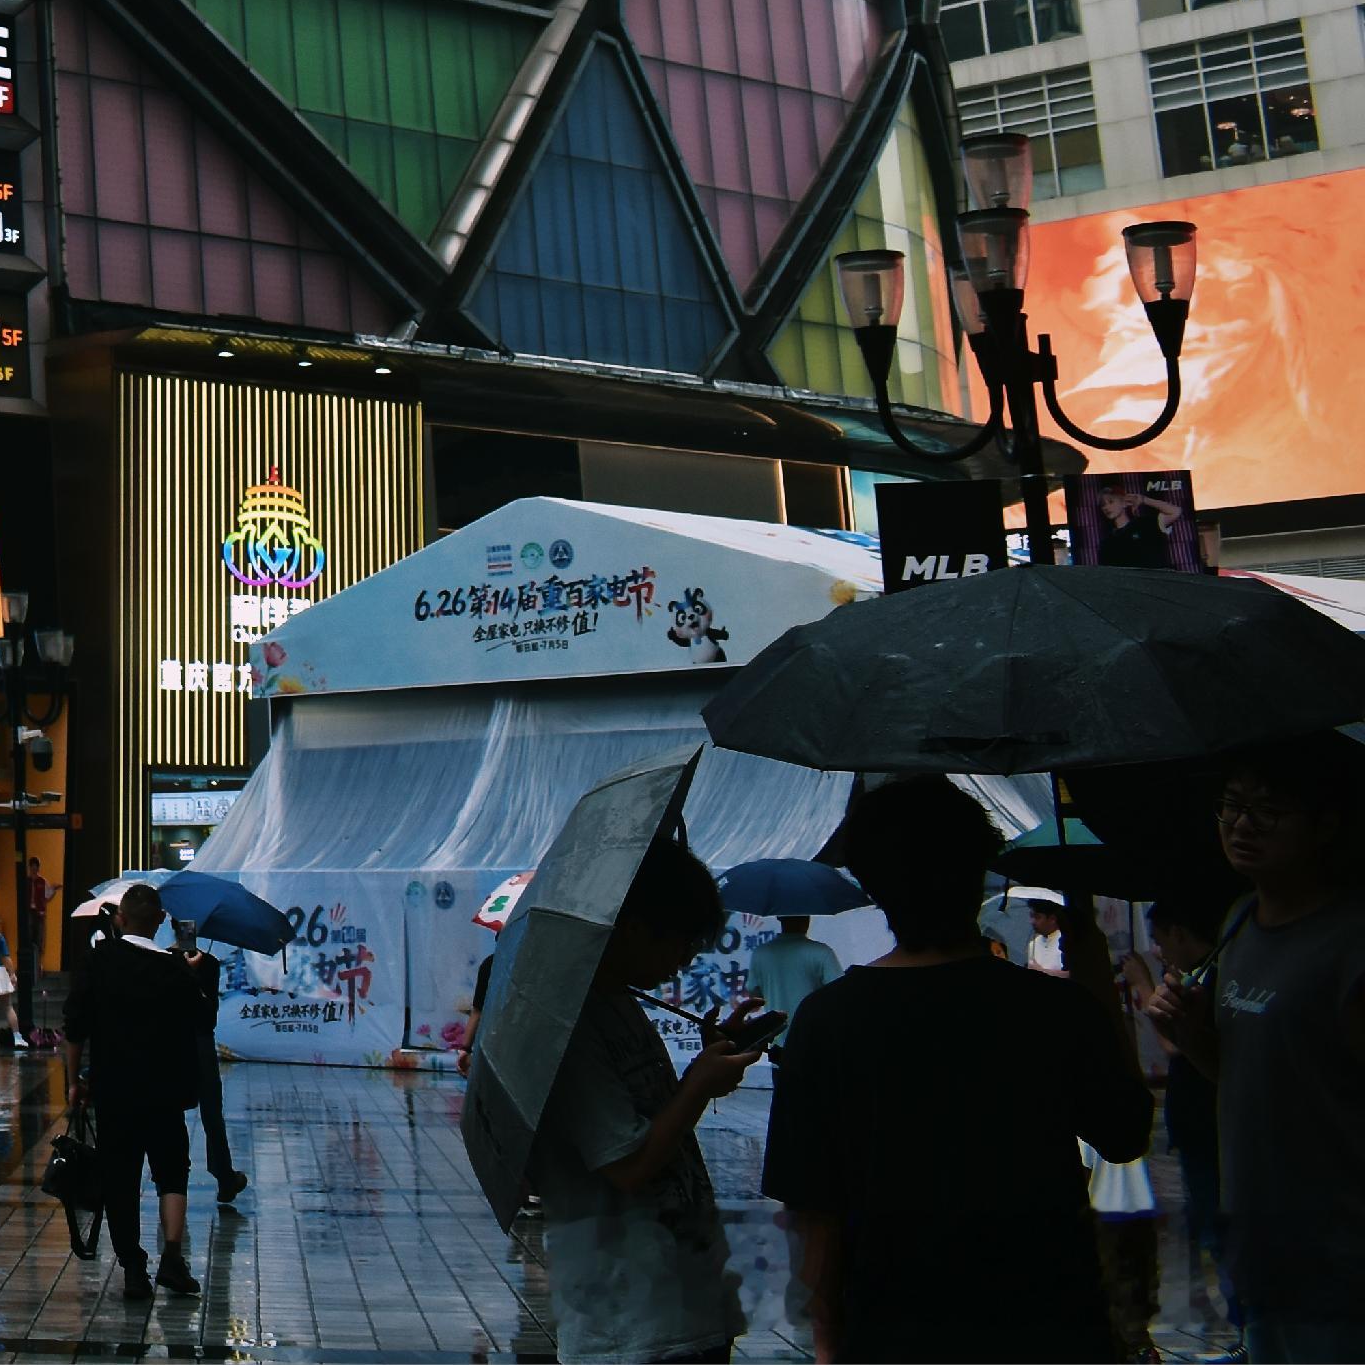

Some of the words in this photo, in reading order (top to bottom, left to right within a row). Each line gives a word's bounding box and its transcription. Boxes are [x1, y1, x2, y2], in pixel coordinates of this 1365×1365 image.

[4, 228, 20, 243] 3F
[1, 328, 23, 347] 5F
[1146, 480, 1183, 492] MLB
[901, 553, 991, 582] MLB
